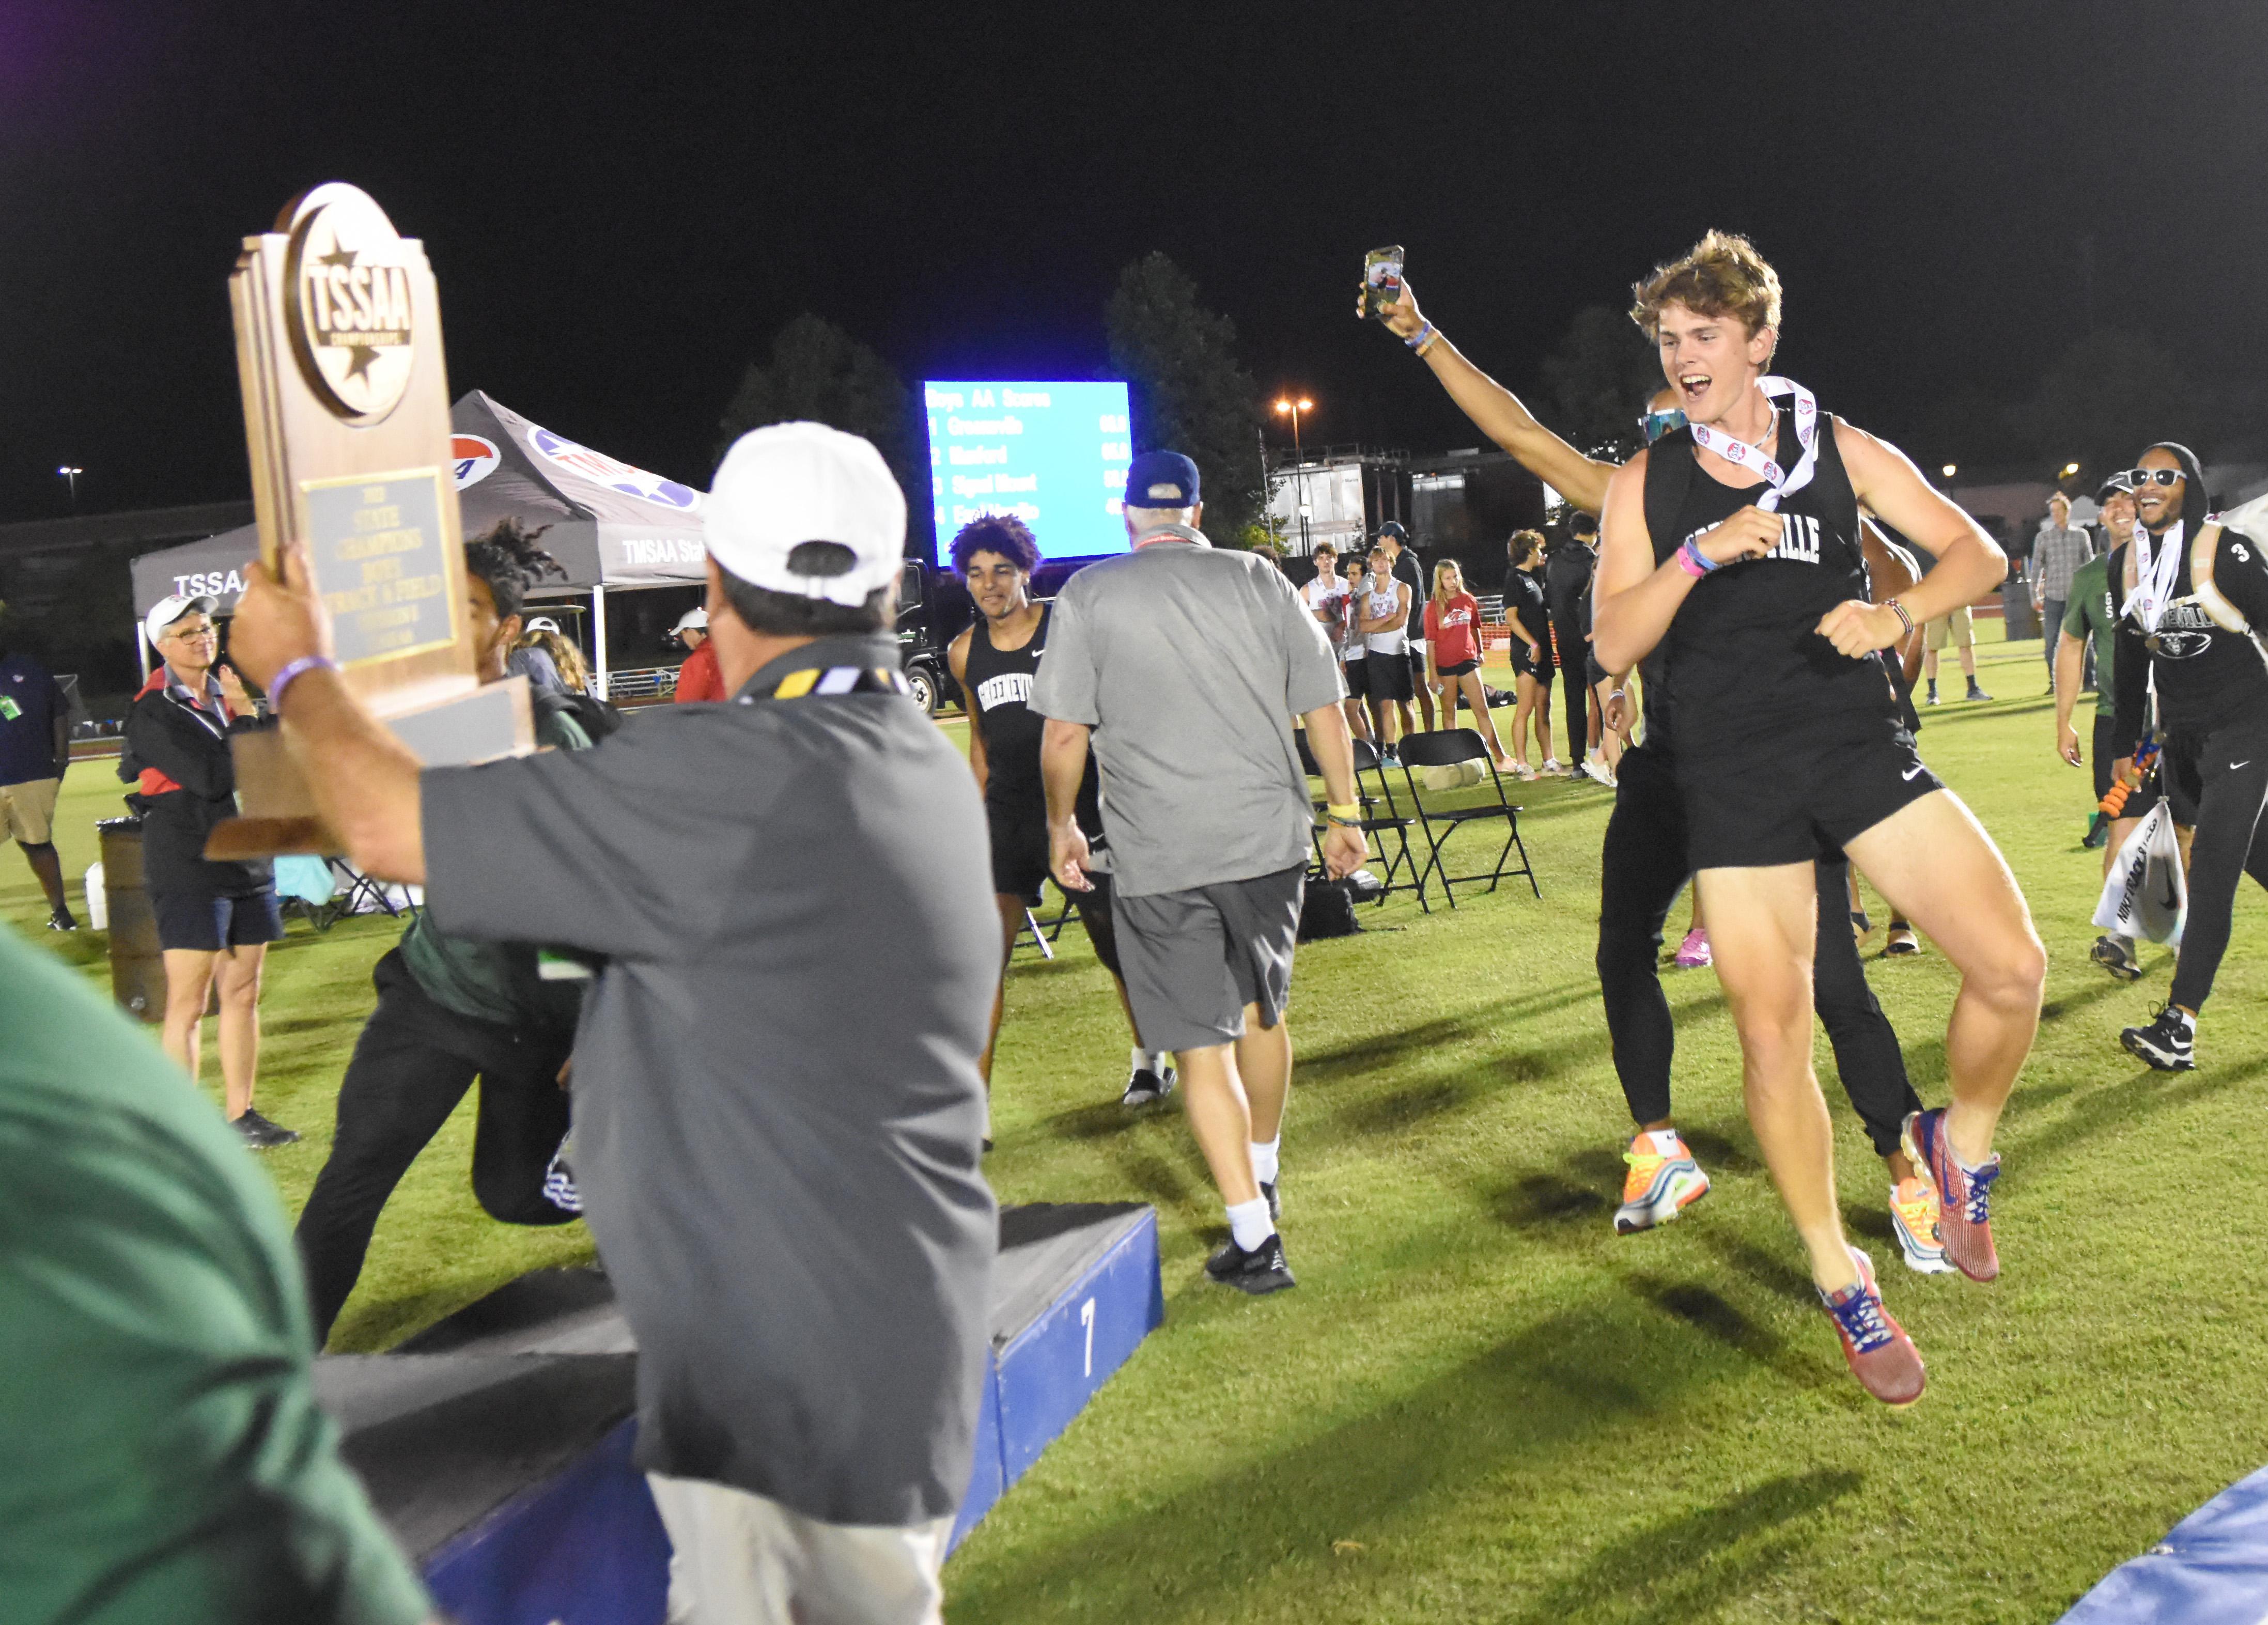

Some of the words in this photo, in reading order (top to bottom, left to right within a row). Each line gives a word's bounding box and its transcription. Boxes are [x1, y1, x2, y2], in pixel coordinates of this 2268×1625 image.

[308, 264, 411, 331] TSSAA
[972, 389, 995, 408] AA
[929, 417, 938, 436] 1
[930, 447, 941, 465] 2
[623, 540, 678, 564] TMSAA
[2231, 543, 2250, 562] 3
[174, 570, 251, 597] TSSA
[977, 673, 1033, 712] GREENEVI
[2117, 893, 2132, 924] NIKE
